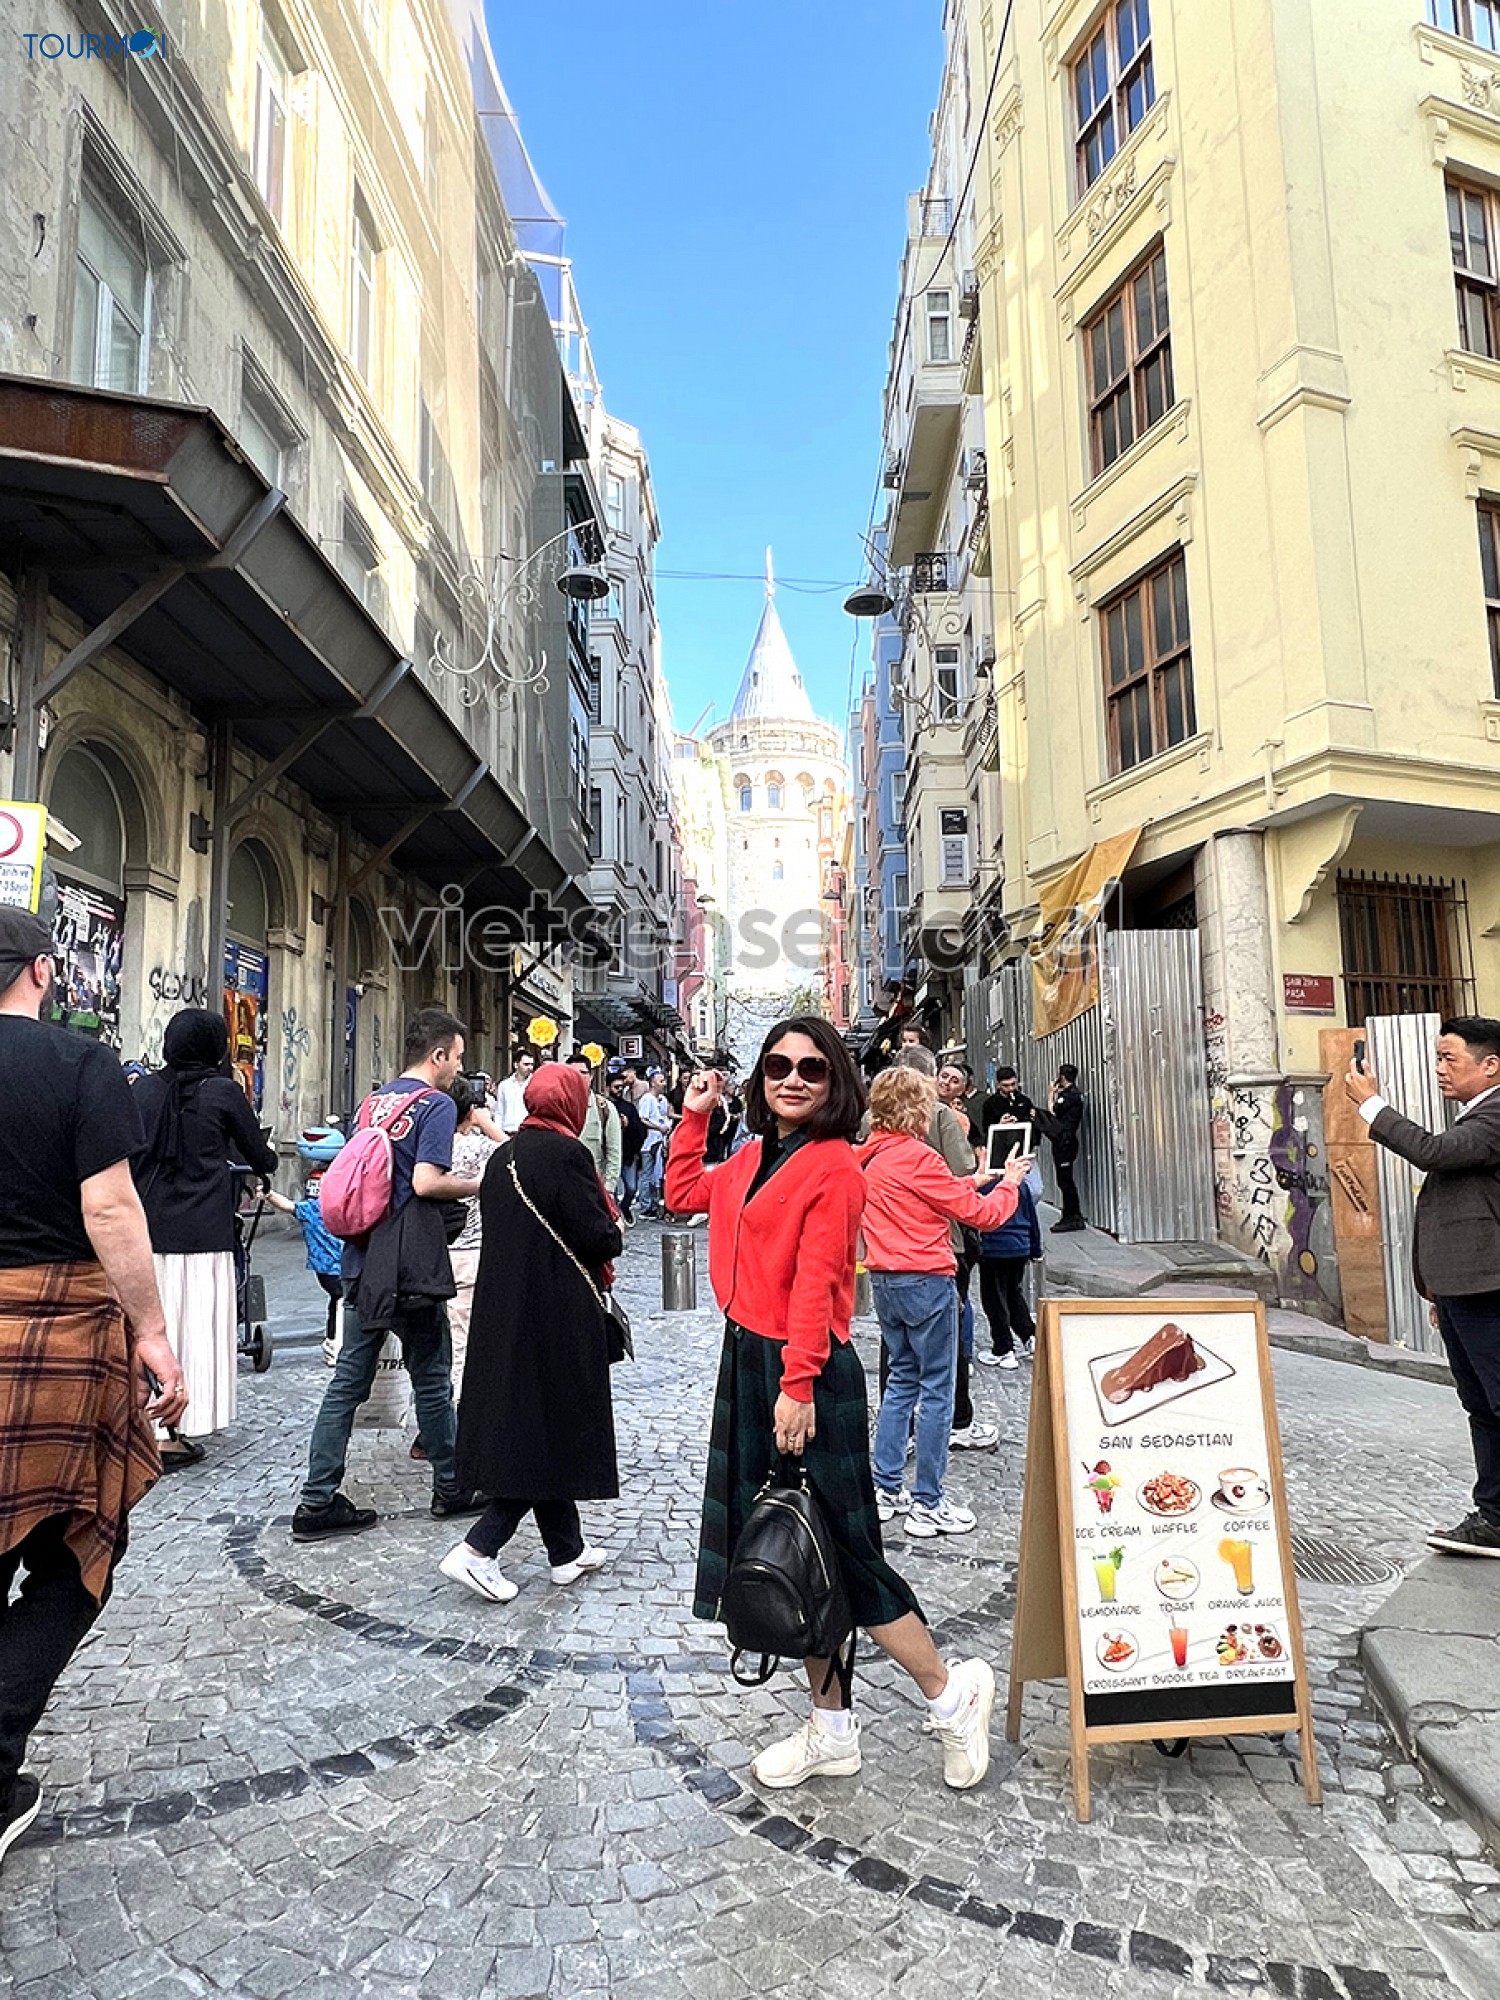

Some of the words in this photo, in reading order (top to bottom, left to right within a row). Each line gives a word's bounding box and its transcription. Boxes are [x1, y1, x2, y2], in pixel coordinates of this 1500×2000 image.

[1099, 1436, 1133, 1450] SAN
[1075, 1527, 1096, 1539] ICE
[1100, 1525, 1142, 1539] CREAM
[1151, 1522, 1199, 1536] WAFFLE
[1223, 1520, 1271, 1532] COFFEE
[1158, 1601, 1196, 1614] TOAST
[1208, 1599, 1251, 1610] ORANGE
[1254, 1597, 1284, 1608] JUICE
[1080, 1604, 1142, 1618] LEMONADE
[1199, 1670, 1220, 1681] TEA
[1086, 1675, 1148, 1691] CROISSANT
